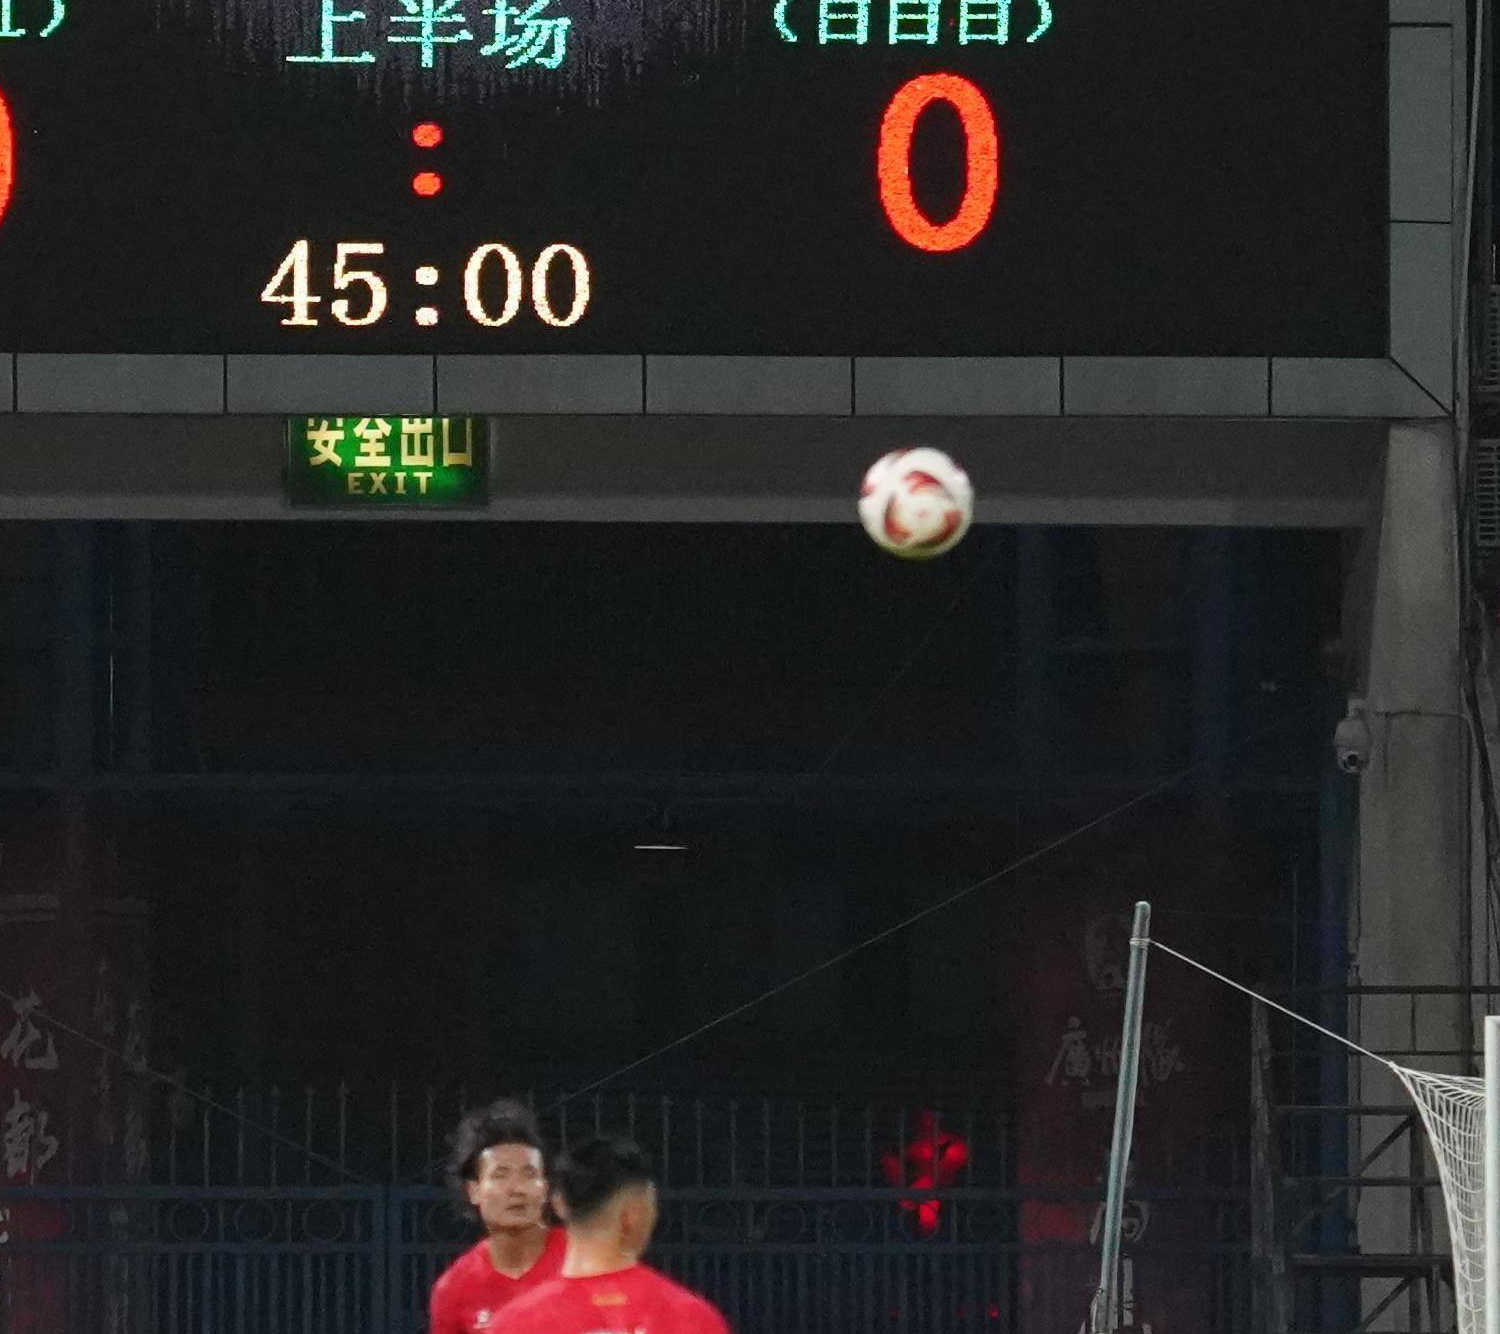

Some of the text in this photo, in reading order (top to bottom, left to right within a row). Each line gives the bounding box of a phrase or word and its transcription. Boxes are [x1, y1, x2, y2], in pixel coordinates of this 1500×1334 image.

[876, 72, 999, 252] 0
[260, 239, 591, 327] 45:00
[306, 417, 473, 468] 安全出口
[347, 471, 433, 495] EXIT
